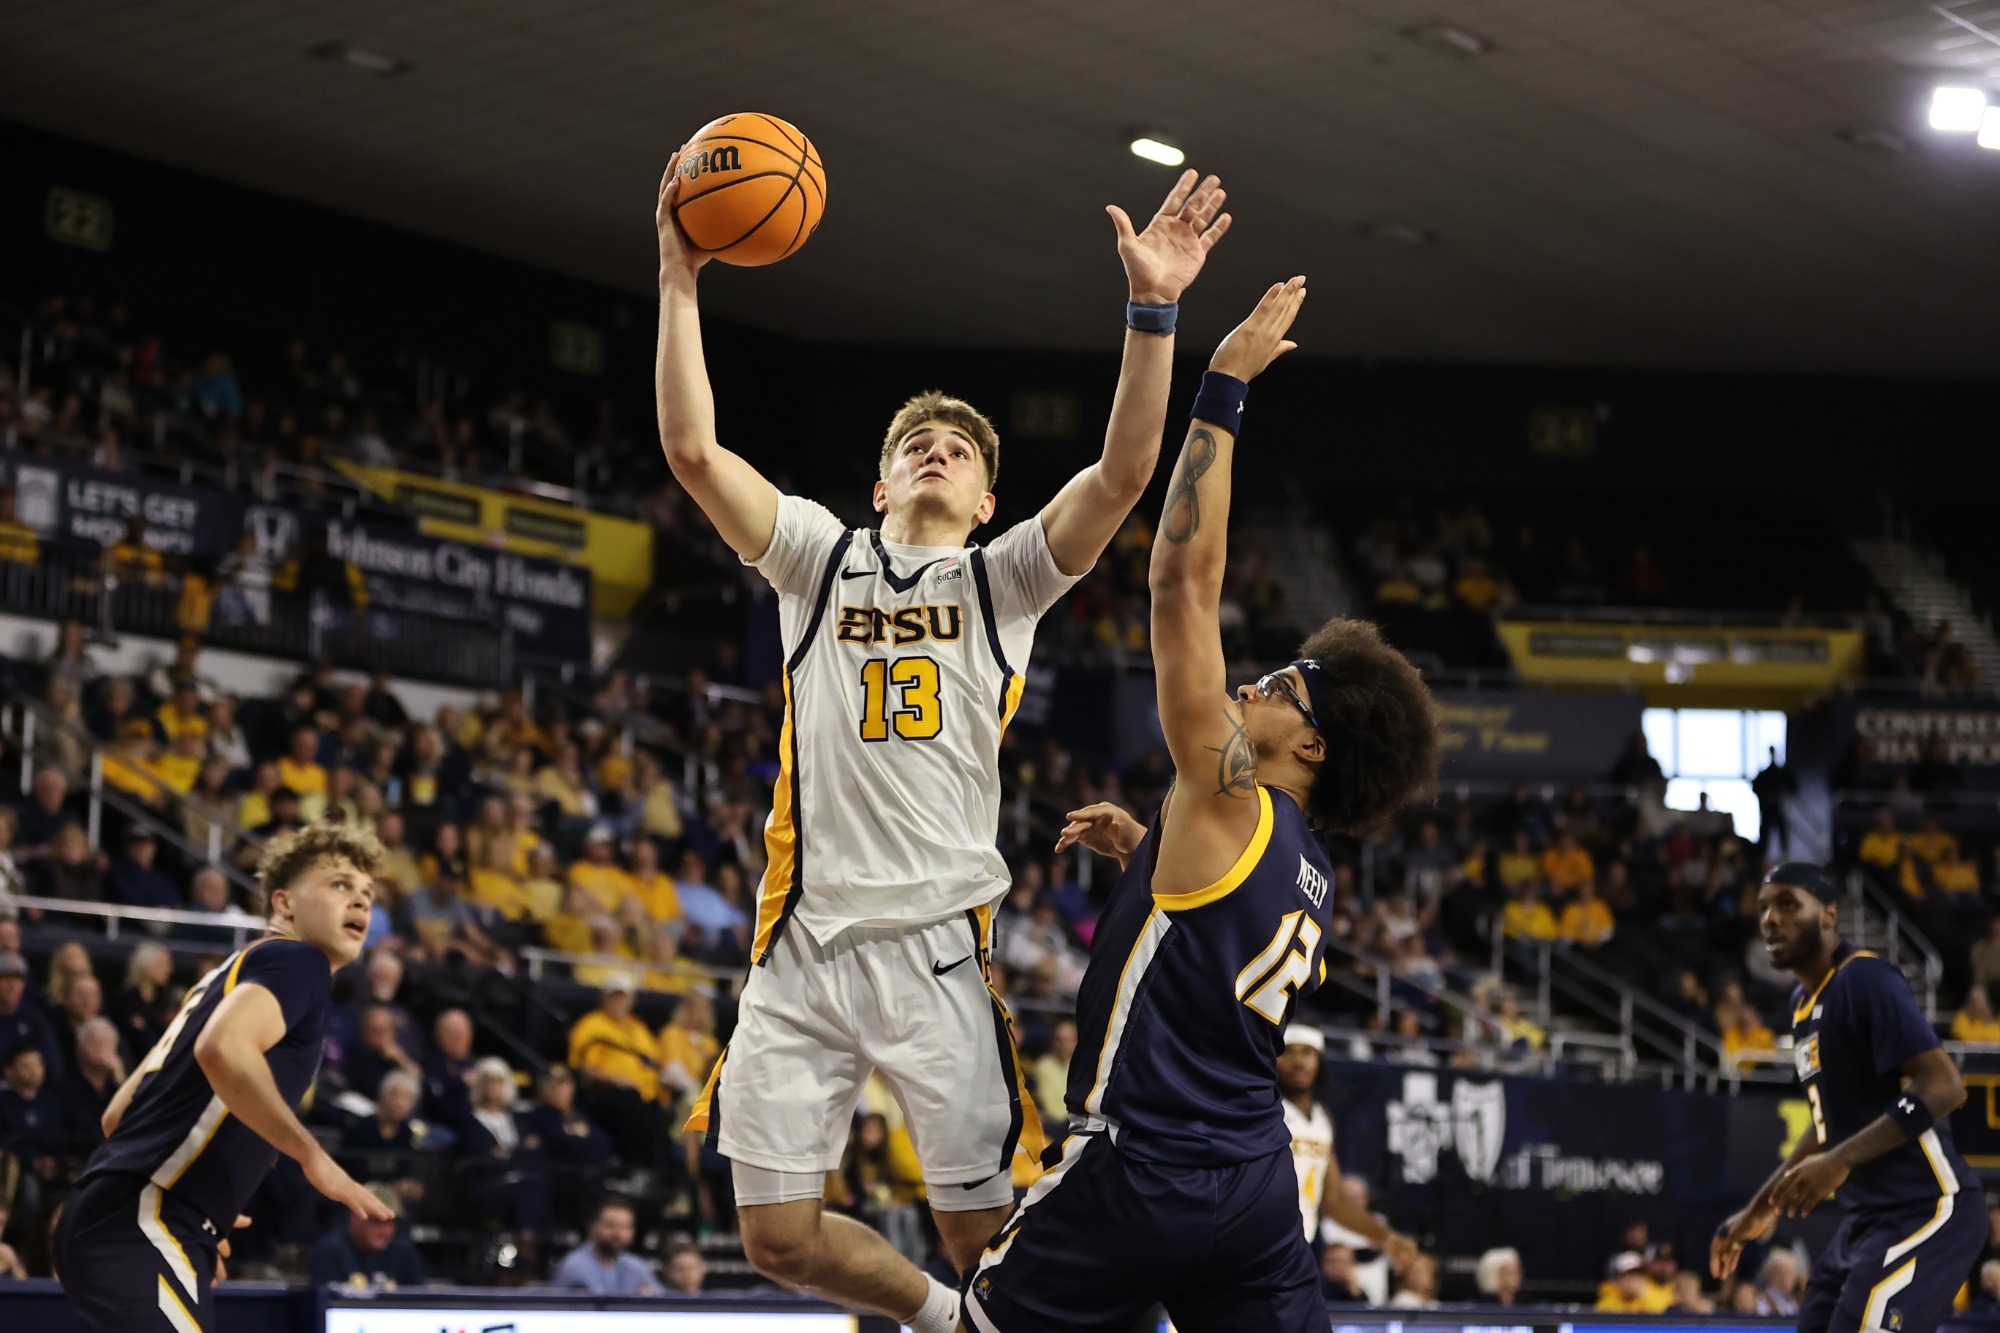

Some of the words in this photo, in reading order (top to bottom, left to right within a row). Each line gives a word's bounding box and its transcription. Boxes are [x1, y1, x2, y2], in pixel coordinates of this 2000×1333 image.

[143, 491, 199, 530] GET
[838, 603, 963, 648] ETSU
[860, 656, 943, 742] 13
[1296, 853, 1328, 910] NEELY
[1235, 909, 1322, 1026] 12
